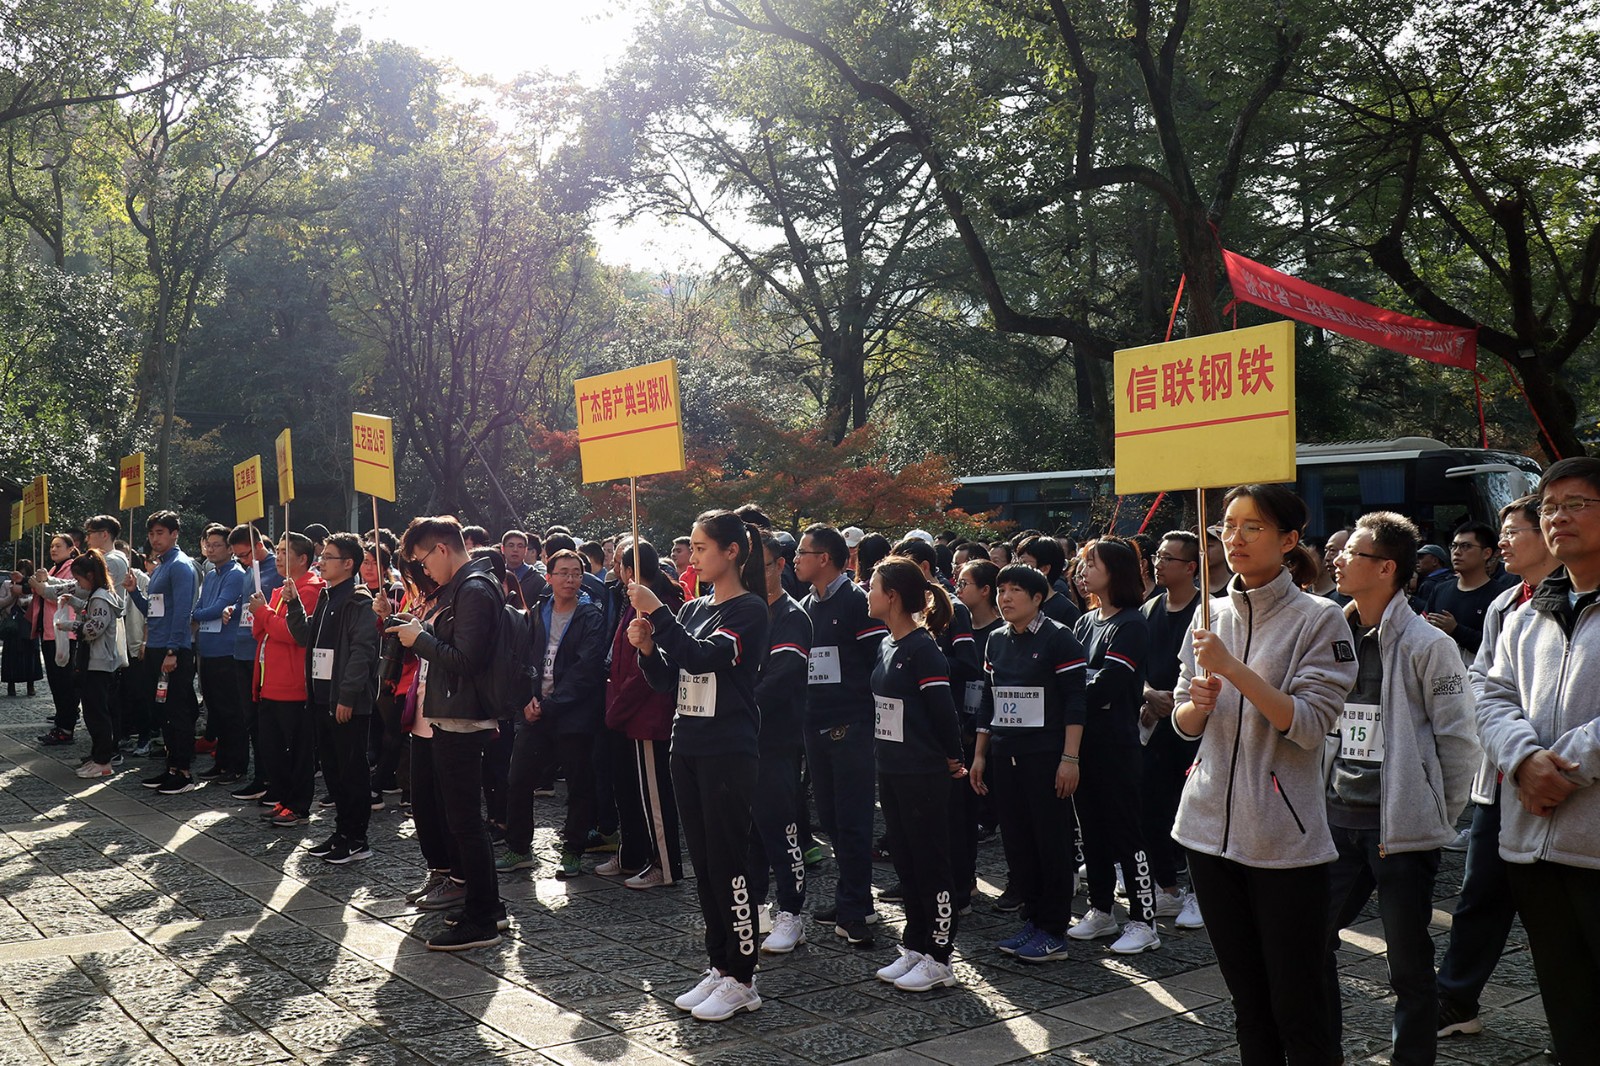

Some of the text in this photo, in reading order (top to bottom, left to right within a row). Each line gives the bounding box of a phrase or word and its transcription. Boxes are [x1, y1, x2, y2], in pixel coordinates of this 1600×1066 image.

[579, 375, 672, 425] 广杰房产典当联队
[1126, 344, 1274, 413] 信联钢铁
[354, 425, 386, 455] 工艺品公司
[1003, 702, 1017, 714] 02
[1350, 726, 1366, 742] 15
[1134, 850, 1154, 920] adidas
[731, 875, 754, 956] adidas
